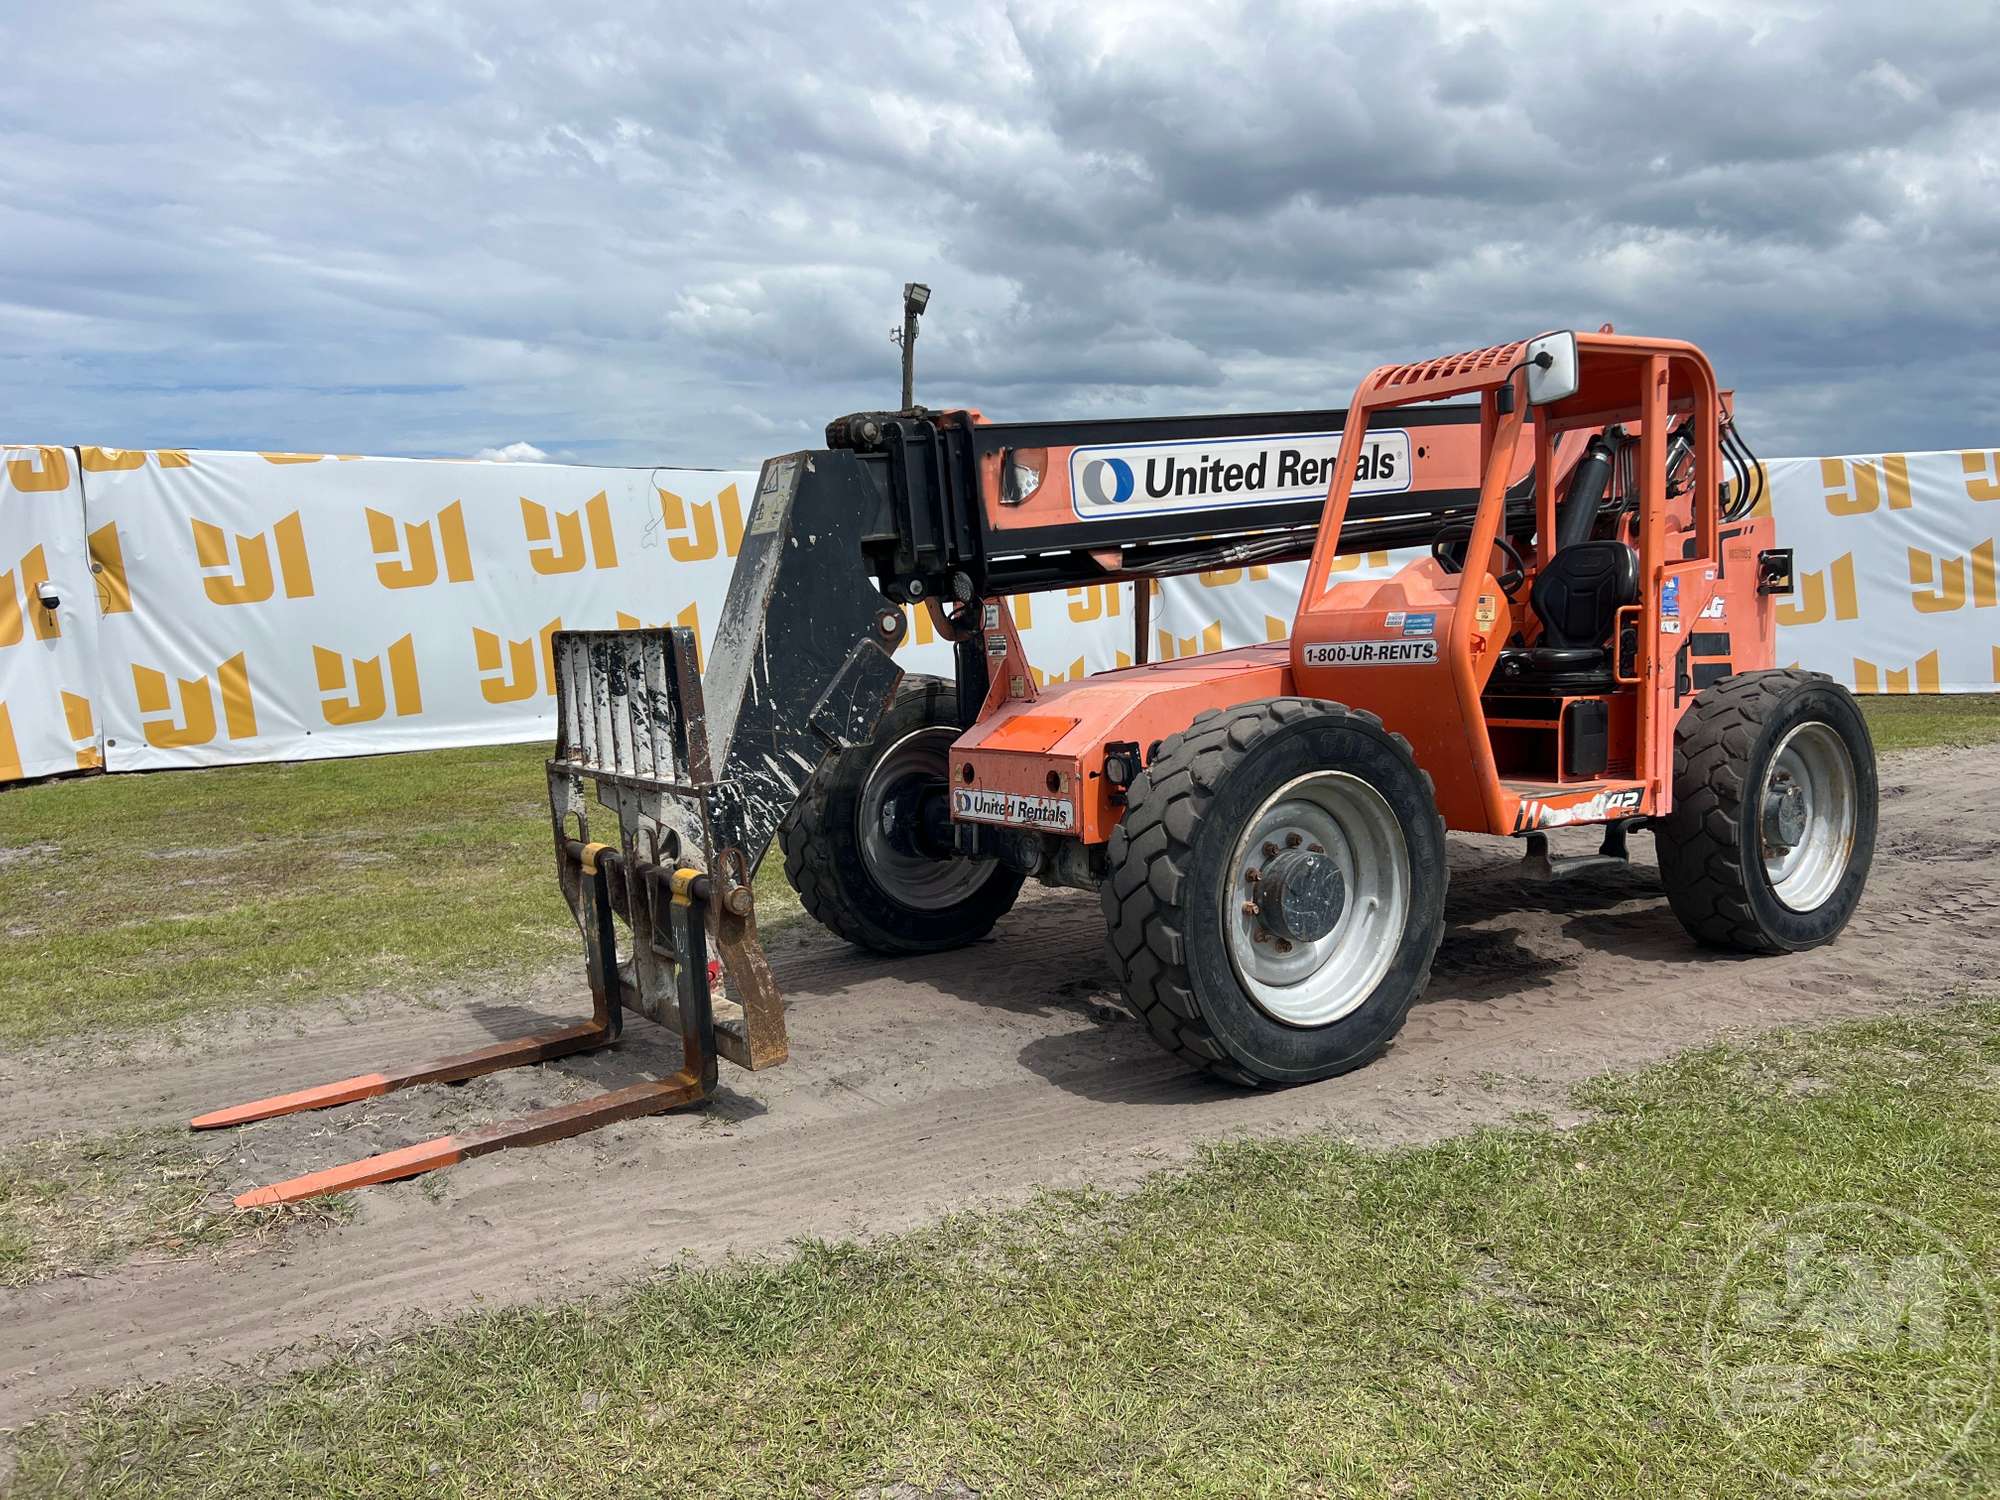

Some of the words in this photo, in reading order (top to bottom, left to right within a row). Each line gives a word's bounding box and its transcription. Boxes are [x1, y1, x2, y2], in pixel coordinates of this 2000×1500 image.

[1145, 451, 1267, 499] United
[1277, 444, 1395, 487] Renals
[1305, 643, 1434, 662] 1-800-UR-RENTS
[974, 796, 1015, 816] United
[1018, 801, 1067, 823] Rentals
